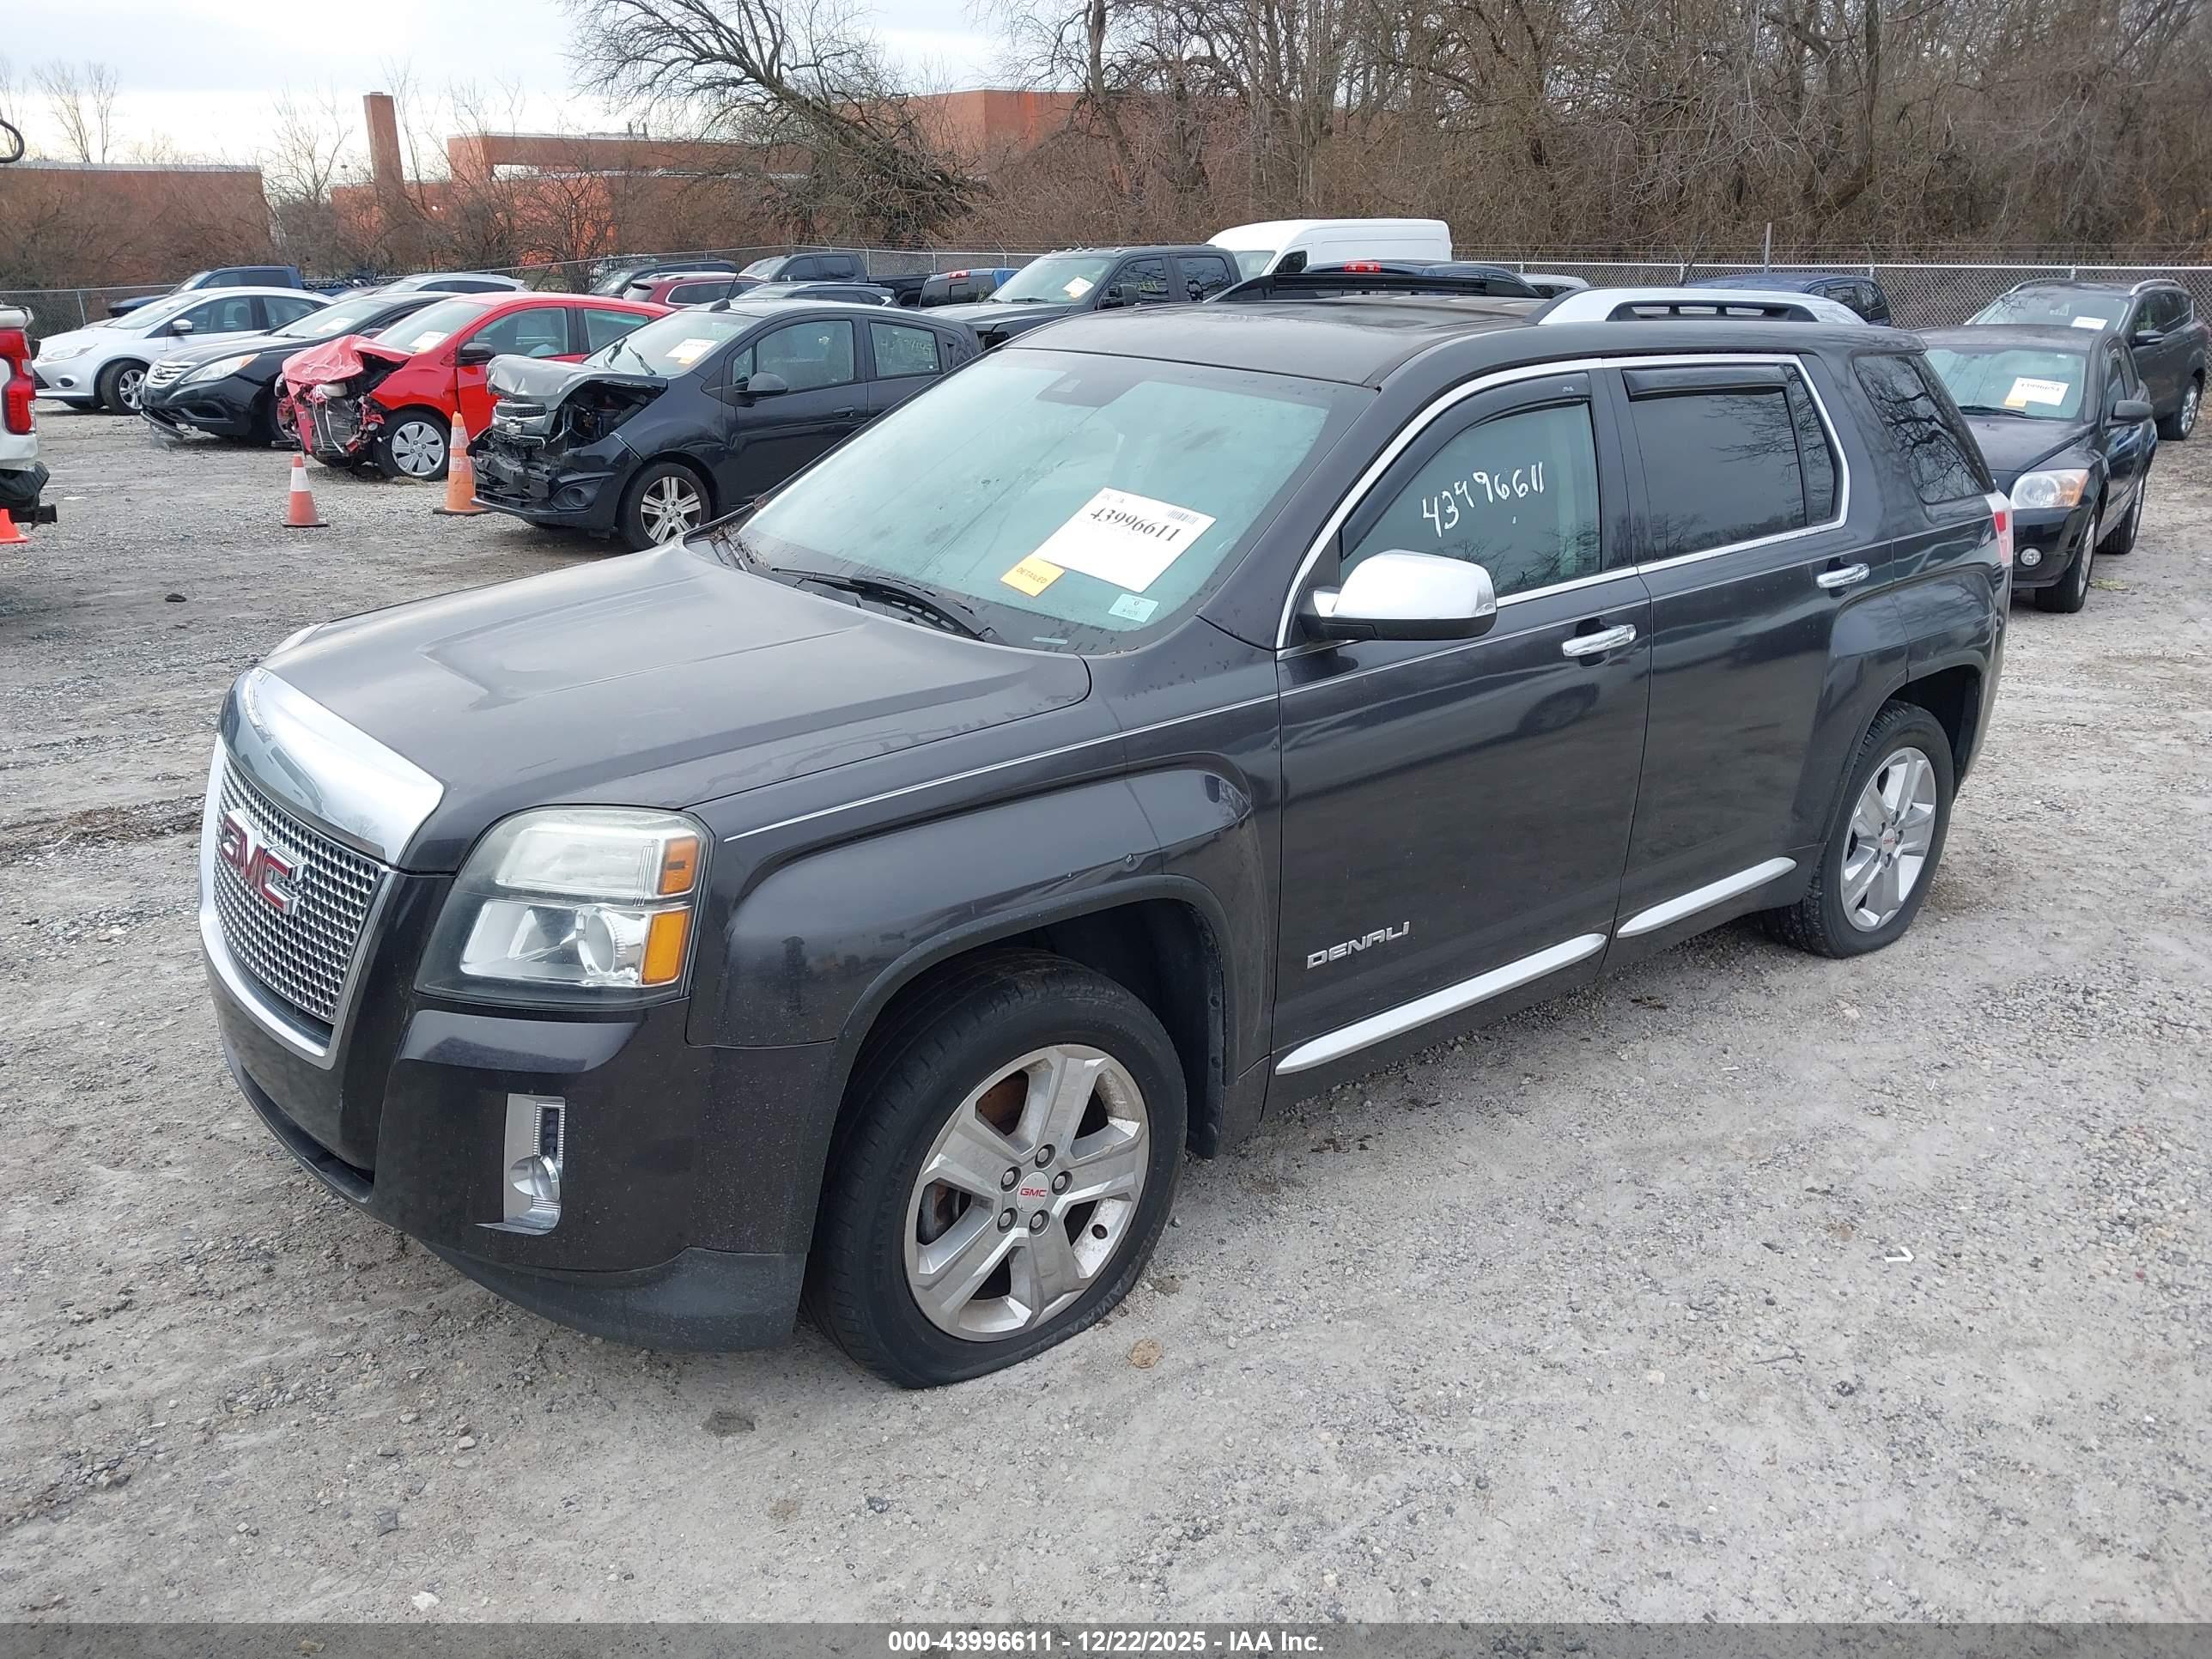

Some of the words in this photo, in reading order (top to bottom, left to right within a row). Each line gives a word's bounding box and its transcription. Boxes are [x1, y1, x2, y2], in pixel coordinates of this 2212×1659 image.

[1090, 507, 1182, 542] 43996611
[1016, 567, 1048, 584] DETAILED
[220, 809, 303, 916] GMC
[1307, 921, 1410, 969] DENALI
[1019, 1188, 1047, 1198] GMC
